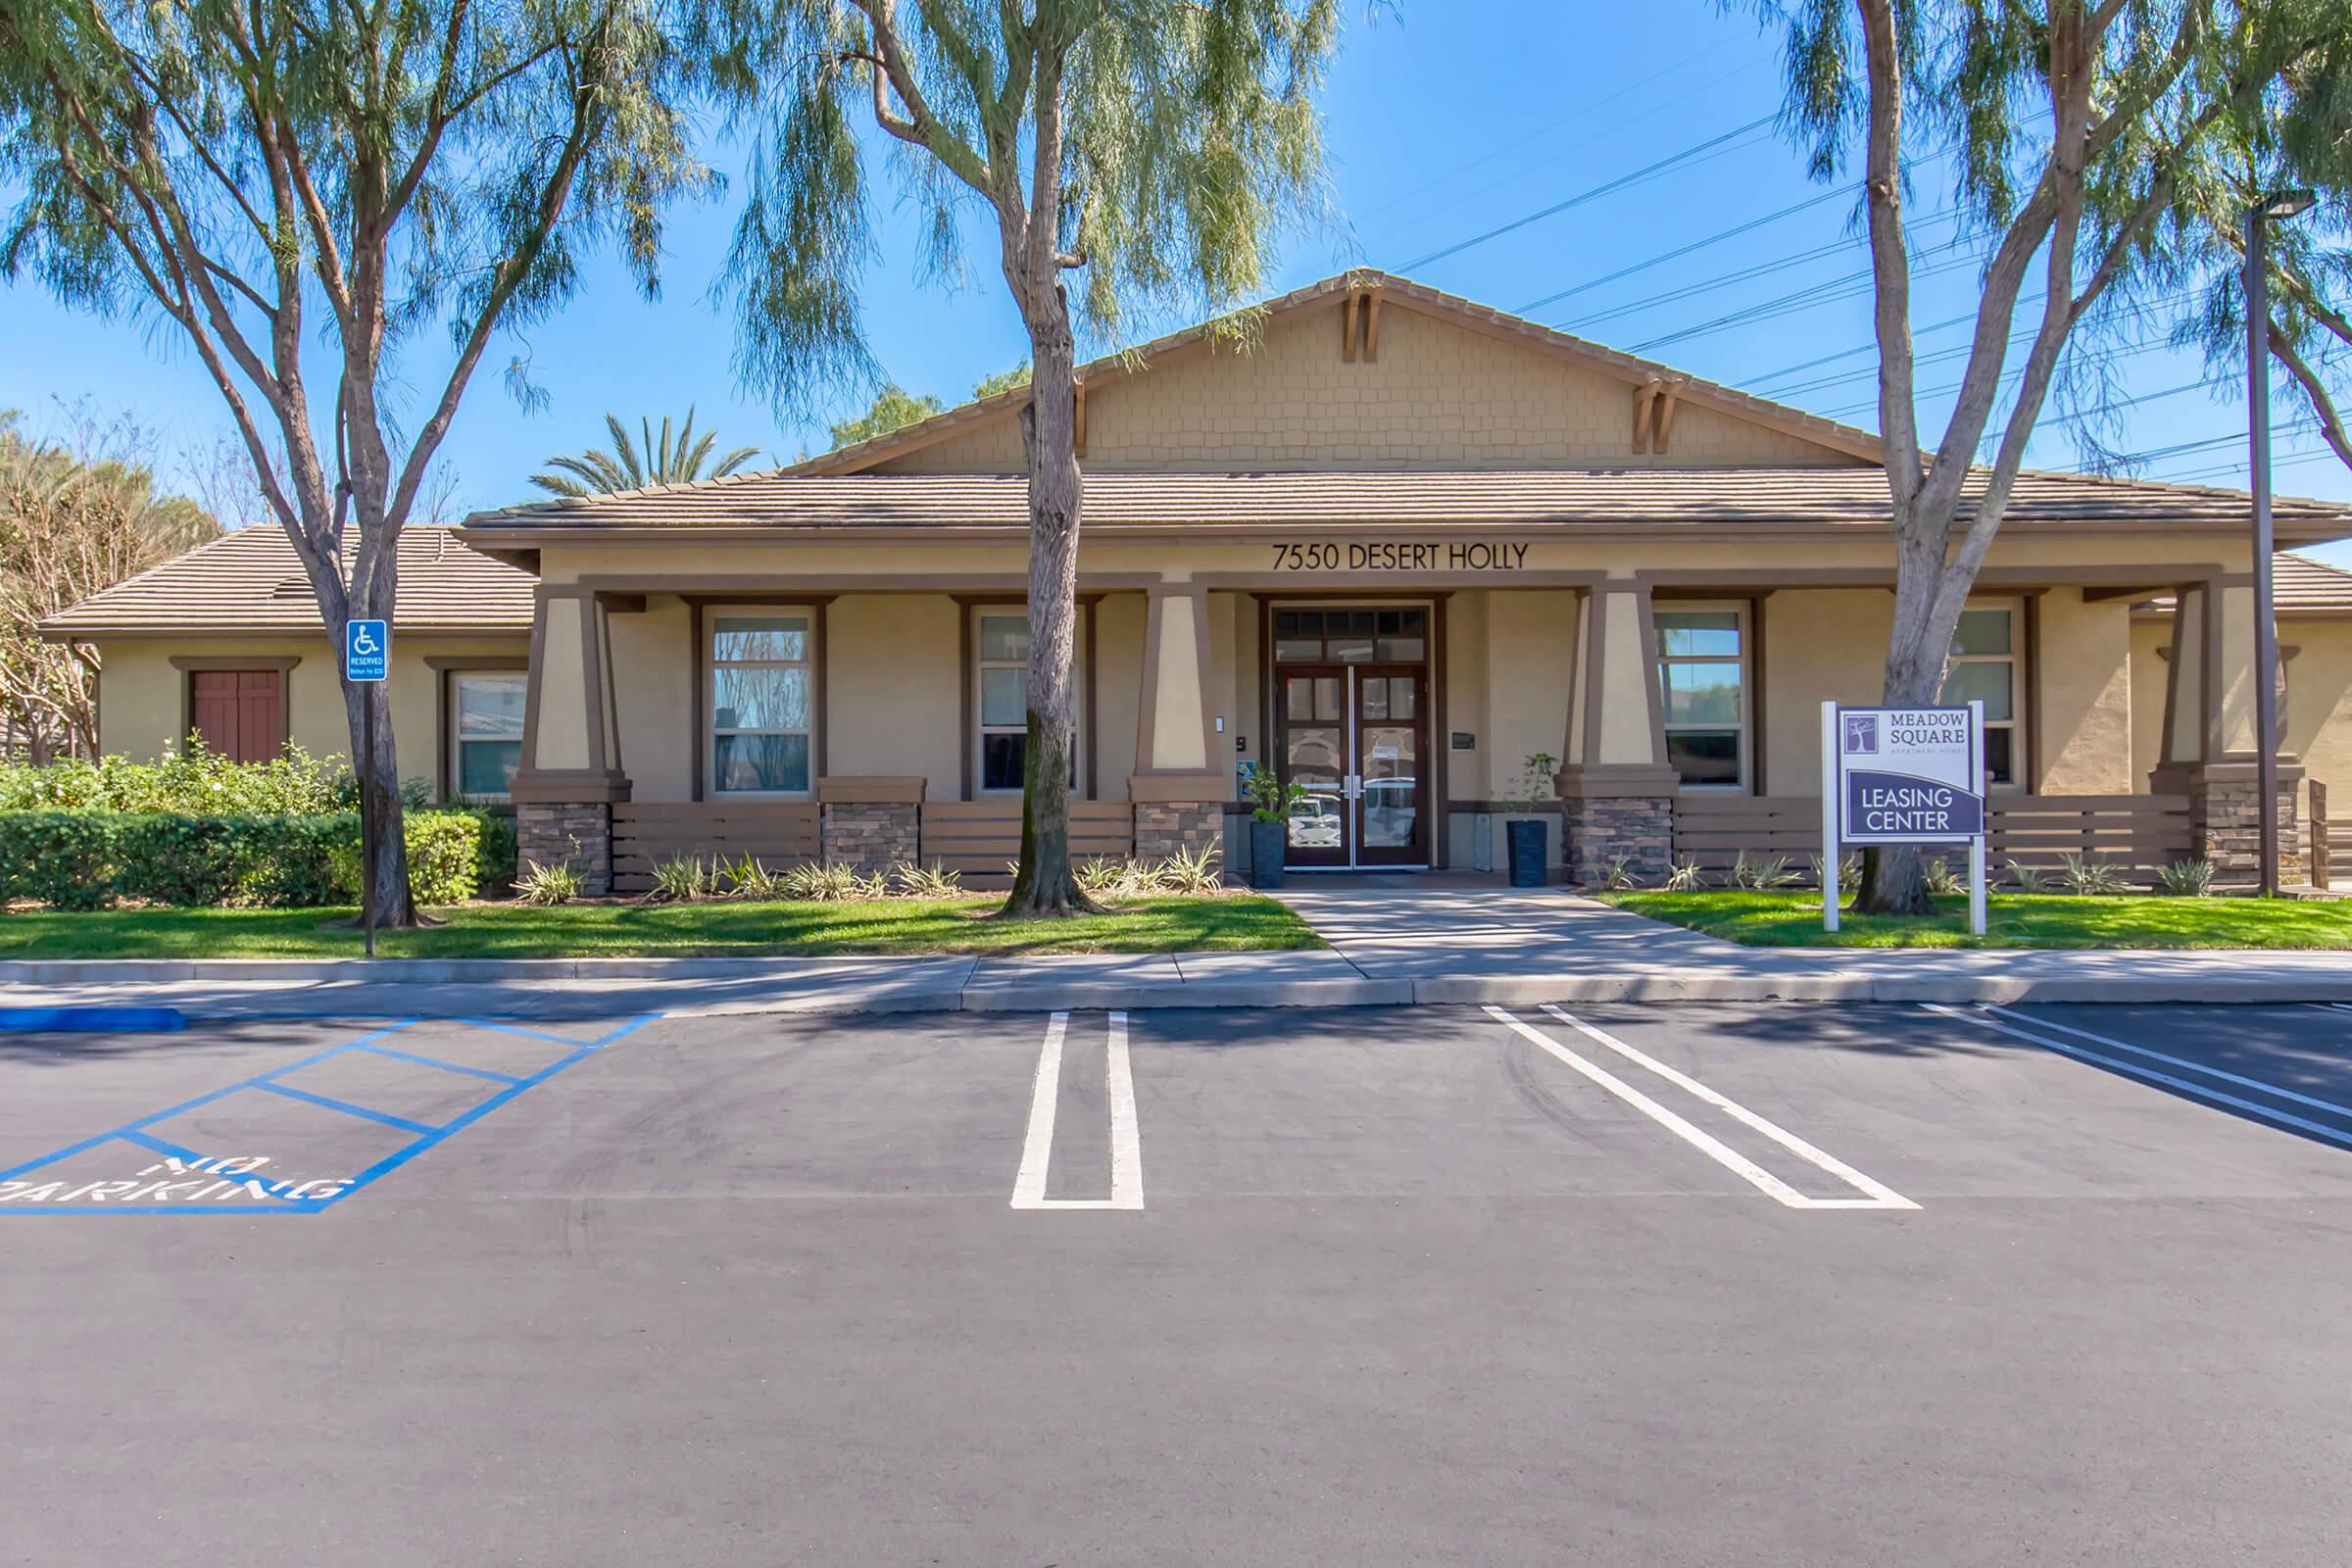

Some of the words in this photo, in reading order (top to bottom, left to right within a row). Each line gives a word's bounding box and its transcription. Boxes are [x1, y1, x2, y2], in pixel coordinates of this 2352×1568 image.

[1272, 543, 1340, 570] 7550
[1348, 543, 1441, 569] DESERT
[1448, 543, 1529, 569] HOLLY
[350, 657, 383, 665] RESERVED
[1890, 713, 1965, 726] MEADOW
[1890, 729, 1965, 746] SQUARE
[1862, 788, 1953, 808] LEASING
[1866, 810, 1950, 831] CENTER
[135, 1156, 270, 1176] NO
